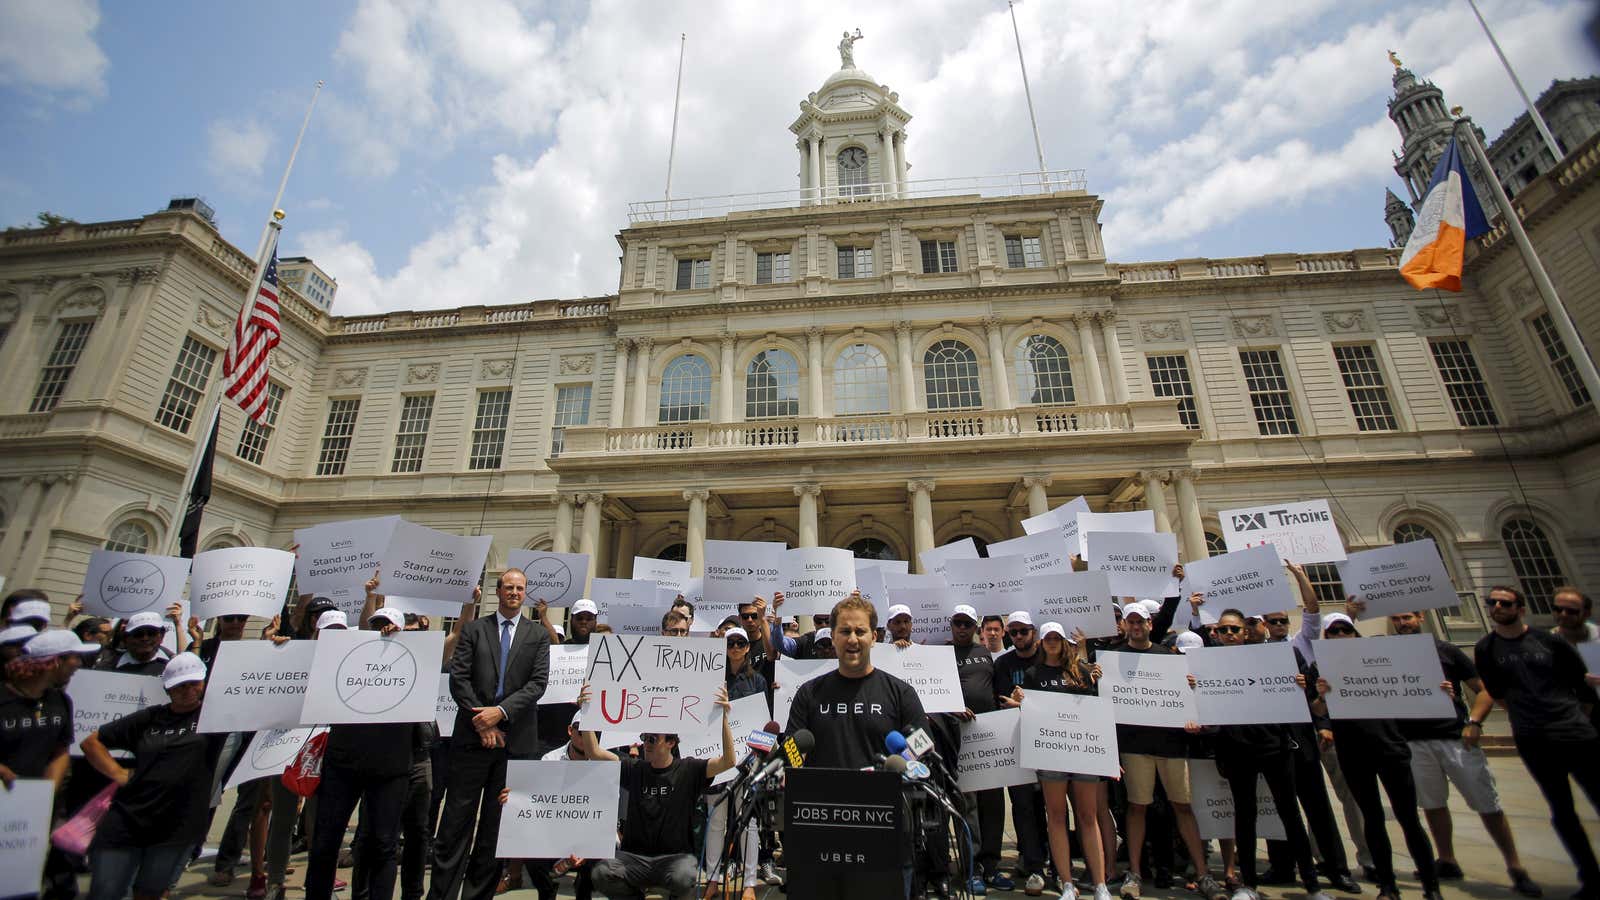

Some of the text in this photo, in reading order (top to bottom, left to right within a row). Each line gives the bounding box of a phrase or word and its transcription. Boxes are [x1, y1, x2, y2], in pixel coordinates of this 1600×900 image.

[313, 551, 374, 567] Stand up for
[1030, 553, 1049, 562] UBER
[1108, 554, 1130, 562] SAVE
[309, 561, 380, 577] Brooklyn Jobs
[403, 560, 468, 576] Stand up for
[1030, 560, 1052, 571] KNOW
[1113, 564, 1128, 572] WE
[1129, 565, 1157, 573] KNOW
[122, 576, 145, 584] TAXI
[393, 570, 470, 587] Brooklyn Jobs
[539, 571, 556, 579] TAXI
[1211, 571, 1260, 587] SAVE UBER
[206, 579, 273, 590] Stand up for
[790, 579, 813, 587] Stand
[830, 579, 842, 587] for
[1360, 574, 1431, 591] Don't Destroy
[107, 585, 155, 596] BAILOUTS
[786, 589, 824, 598] Brooklyn
[1207, 579, 1275, 598] AS WE KNOW IT
[1366, 584, 1434, 601] Queens Jobs
[200, 588, 276, 602] Brooklyn Jobs
[1066, 596, 1088, 604] UBER
[1050, 607, 1063, 615] WE
[1064, 606, 1090, 614] KNOW
[1093, 604, 1101, 612] IT
[912, 626, 939, 635] ooklyn
[588, 635, 724, 682] AX TRADING
[366, 663, 392, 672] TAXI
[240, 671, 309, 681] SAVE UBER
[1197, 678, 1246, 688] $552,640
[1259, 675, 1297, 686] 10,000
[1343, 674, 1420, 685] Stand up for
[346, 677, 406, 687] BAILOUTS
[916, 679, 927, 687] up
[224, 685, 308, 695] AS WE KNOW
[929, 687, 951, 695] Jobs
[1112, 685, 1181, 698] Don't Destroy
[1340, 686, 1433, 698] Brooklyn Jobs
[601, 689, 702, 724] UBER
[1112, 696, 1185, 708] Brooklyn Jobs
[75, 709, 109, 720] Don't
[820, 703, 883, 715] UBER
[4, 715, 62, 729] UBER
[1040, 727, 1100, 741] Stand up for
[695, 742, 720, 757] Don't
[958, 744, 1016, 760] on't Destroy
[1034, 740, 1106, 755] Brooklyn Jobs
[957, 757, 1017, 774] Queens Jobs
[531, 794, 590, 804] SAVE UBER
[517, 809, 603, 819] AS WE KNOW IT
[793, 807, 894, 823] JOBS FOR NYC
[820, 852, 865, 863] UBER
